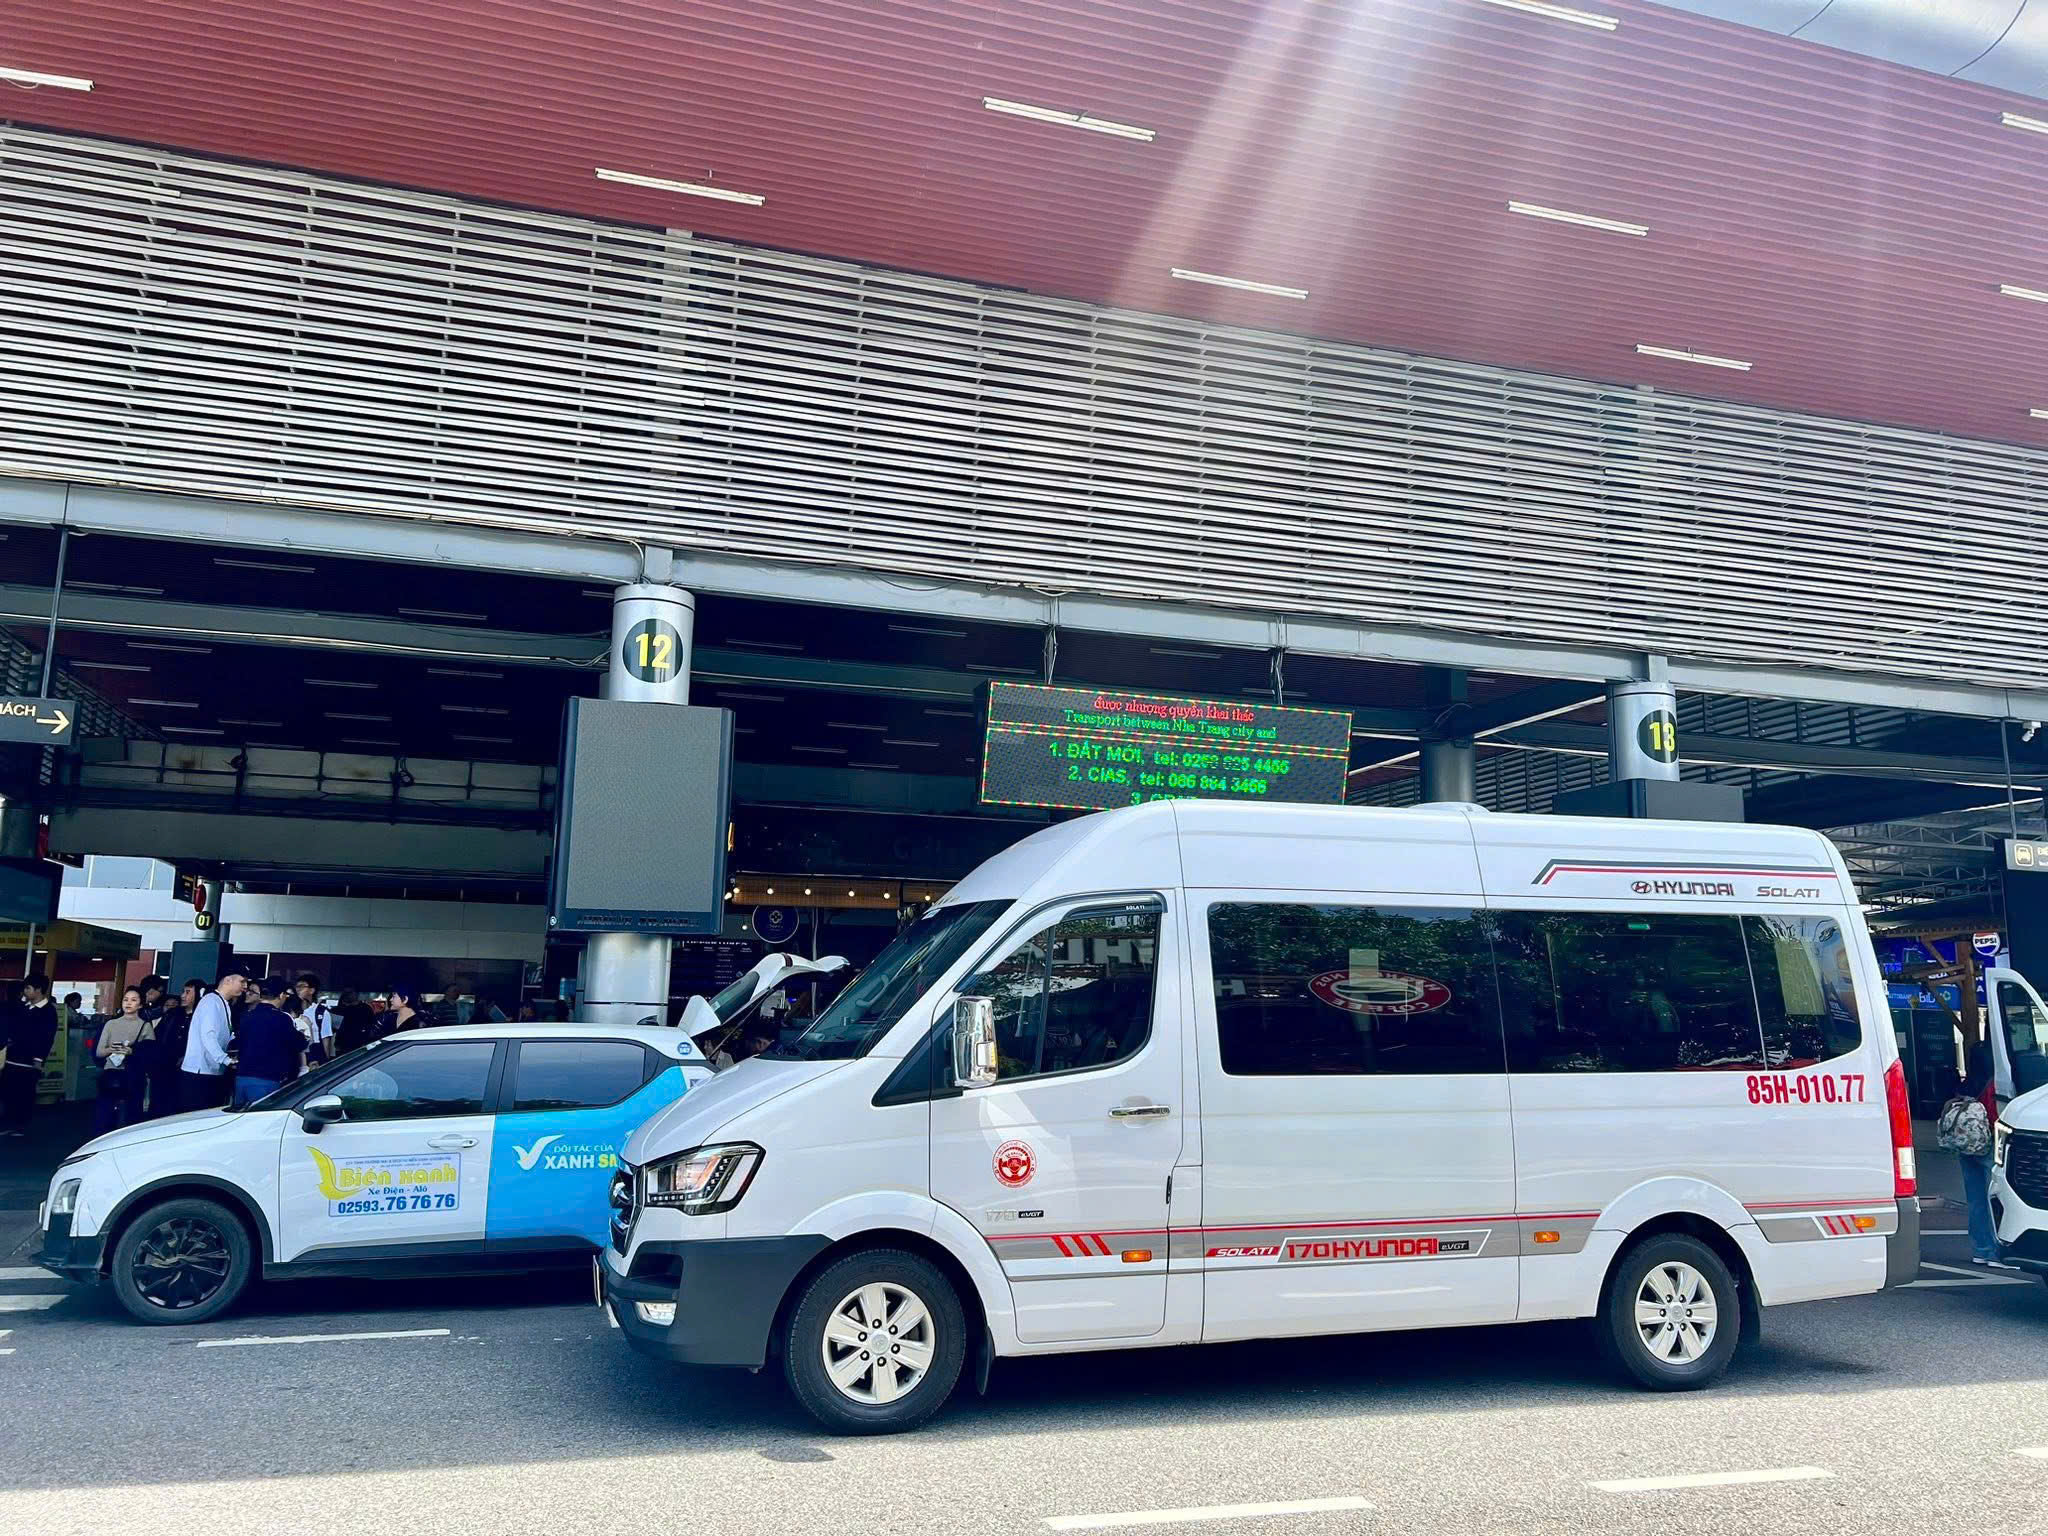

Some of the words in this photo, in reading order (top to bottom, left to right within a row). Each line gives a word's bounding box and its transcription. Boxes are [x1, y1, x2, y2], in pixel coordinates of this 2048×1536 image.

[635, 633, 673, 669] 12
[1206, 706, 1229, 719] khai
[1064, 709, 1120, 728] Transport
[1123, 714, 1169, 730] between
[1173, 719, 1195, 732] Nha
[1198, 721, 1230, 738] Trang
[1231, 723, 1254, 739] city
[1256, 726, 1278, 738] and
[1650, 722, 1676, 752] 13
[1049, 742, 1062, 757] 1.
[1153, 751, 1179, 766] tel:
[1068, 765, 1082, 780] 2.
[1087, 766, 1131, 786] CIAS,
[1140, 771, 1165, 787] tel:
[1654, 881, 1735, 896] HYUNDAI
[1756, 886, 1820, 898] SOLATI
[198, 915, 211, 926] 01
[1974, 937, 1997, 945] PEPSI
[1746, 1074, 1865, 1104] 85H-010.77
[544, 1154, 595, 1169] XANH
[368, 1187, 380, 1195] Xe
[383, 1186, 404, 1196] Điện
[337, 1196, 407, 1214] 02593.76
[410, 1194, 431, 1210] 76
[434, 1193, 455, 1208] 76
[1215, 1246, 1274, 1257] SOLATI
[1333, 1238, 1438, 1258] HYUNDAI
[1441, 1241, 1467, 1250] eVGT
